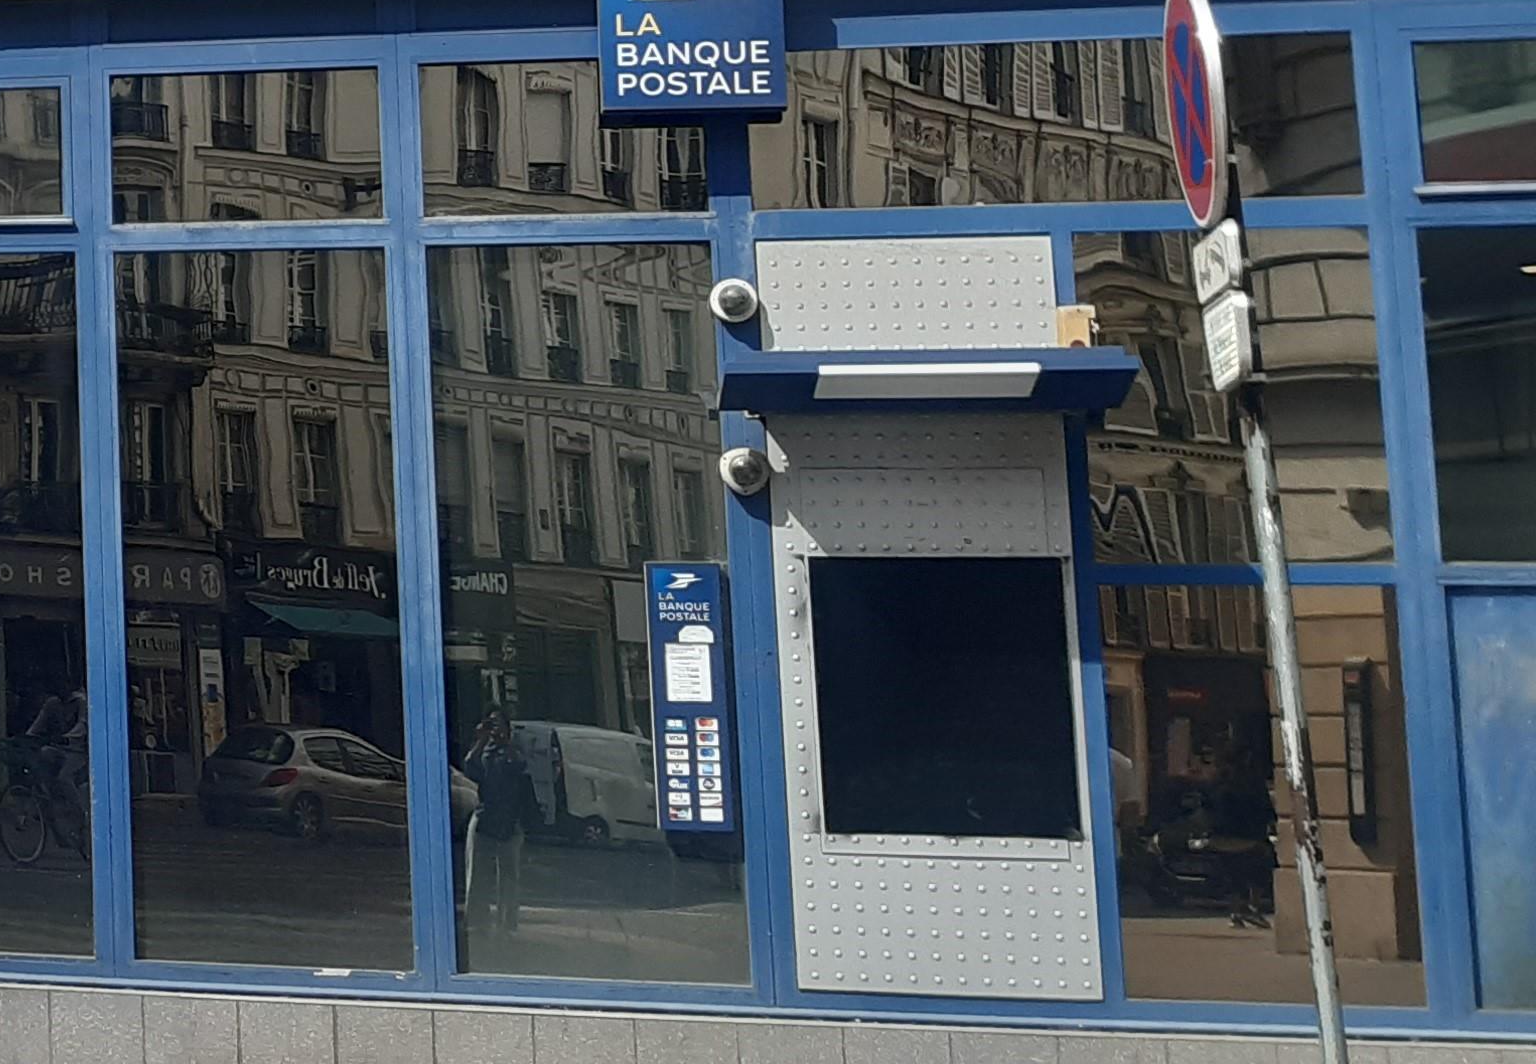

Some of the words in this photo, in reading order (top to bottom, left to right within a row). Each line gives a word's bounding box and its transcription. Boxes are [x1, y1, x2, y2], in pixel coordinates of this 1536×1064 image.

[616, 13, 661, 36] LA
[617, 40, 770, 67] BANQUE
[618, 70, 771, 96] POSTALE
[658, 592, 674, 601] LA
[658, 602, 710, 611] BANQUE
[659, 612, 710, 621] POSTALE
